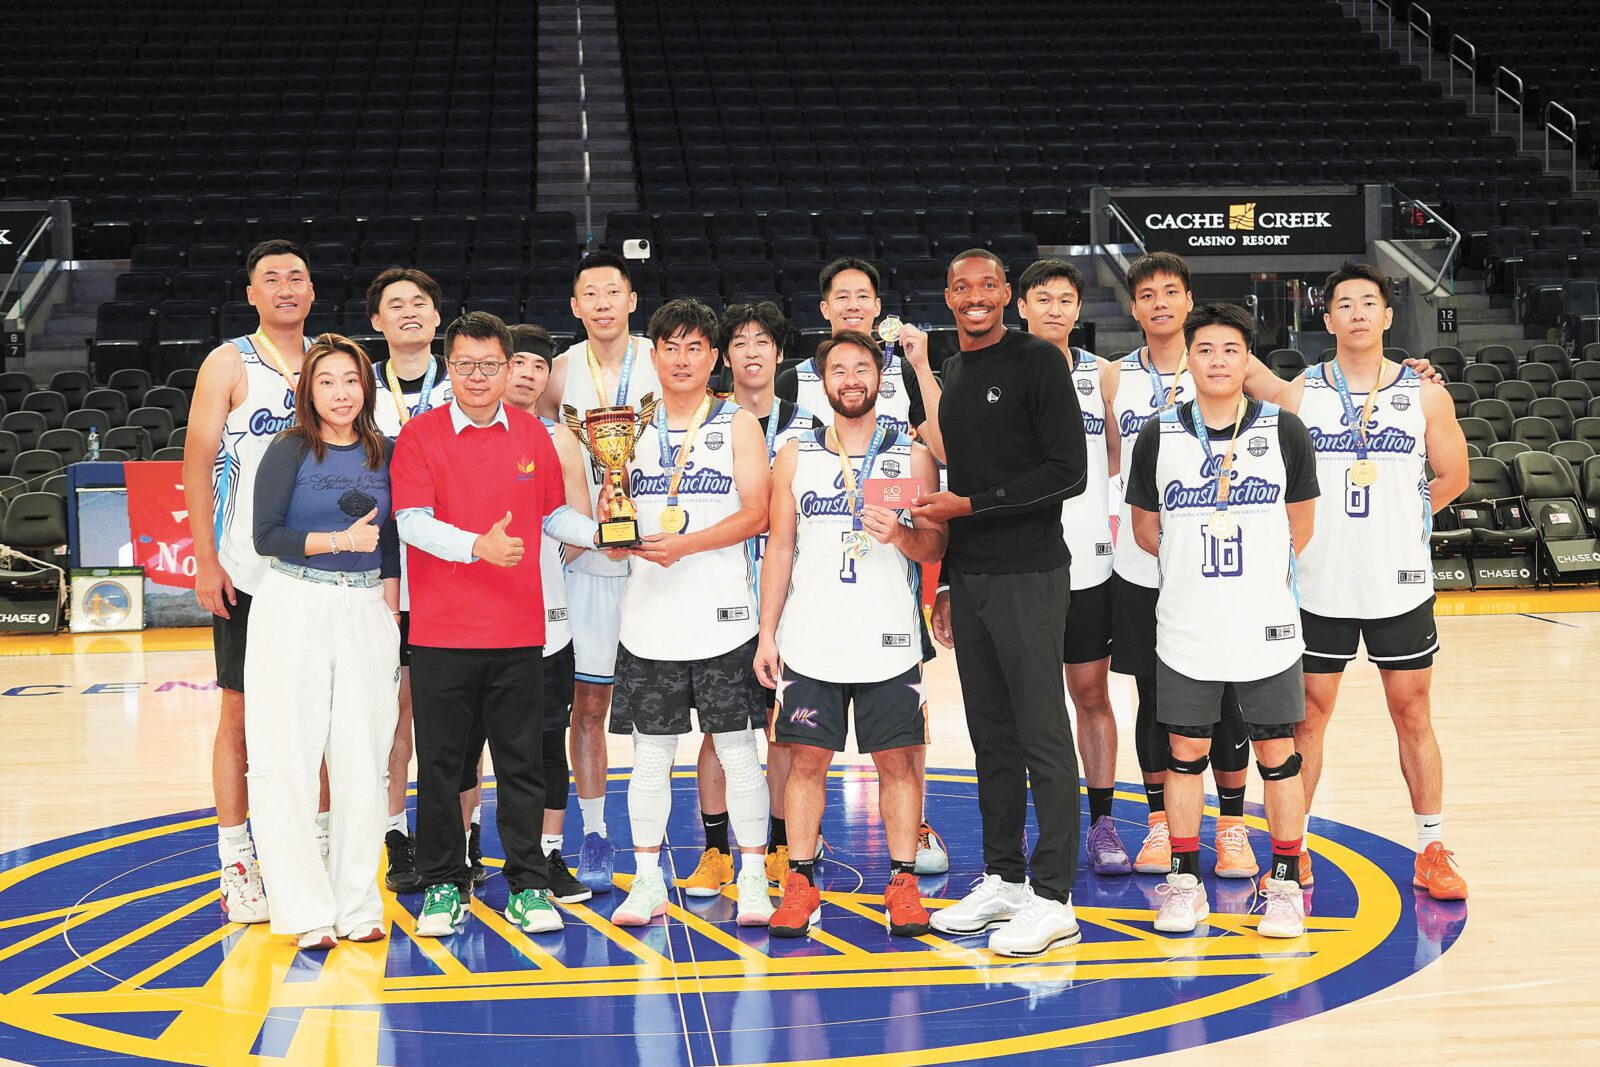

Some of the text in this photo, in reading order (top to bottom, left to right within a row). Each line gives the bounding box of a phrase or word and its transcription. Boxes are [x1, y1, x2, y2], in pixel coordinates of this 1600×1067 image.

[1145, 212, 1332, 230] CACHE CREEK
[1188, 234, 1290, 247] CASINO RESORT
[1441, 310, 1454, 319] 12
[1441, 322, 1452, 331] 11
[11, 346, 18, 356] 7
[1307, 426, 1416, 454] Constuction
[631, 467, 733, 498] Consuction
[1164, 476, 1281, 511] Constuction
[1201, 524, 1243, 578] 16
[1557, 553, 1592, 563] CHASE
[1432, 571, 1454, 580] ASE
[1479, 569, 1519, 578] CHASE
[1, 680, 219, 697] CEN
